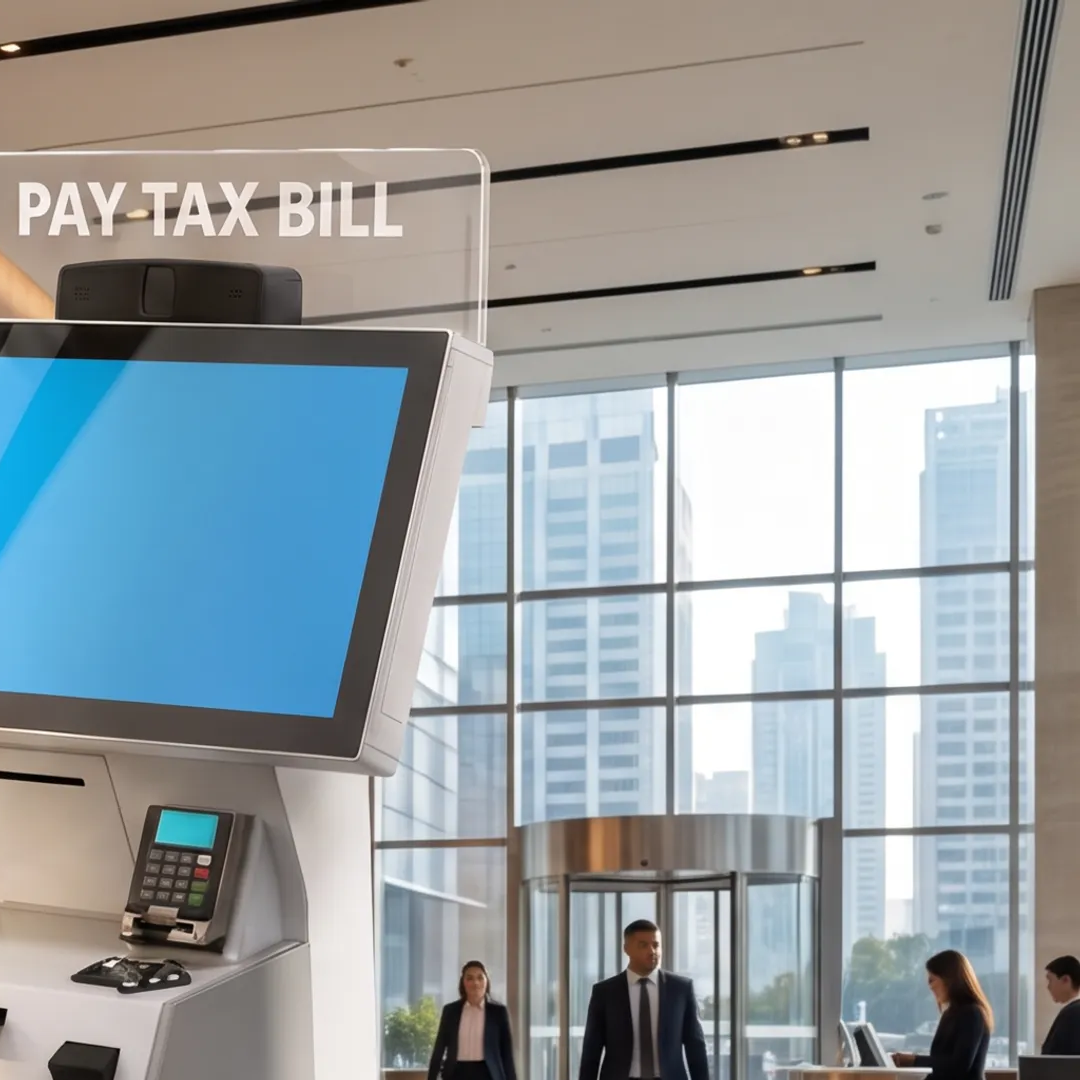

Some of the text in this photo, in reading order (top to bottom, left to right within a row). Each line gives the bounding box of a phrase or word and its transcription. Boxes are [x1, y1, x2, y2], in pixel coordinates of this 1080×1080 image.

[18, 181, 403, 238] PAY TAX BILL
